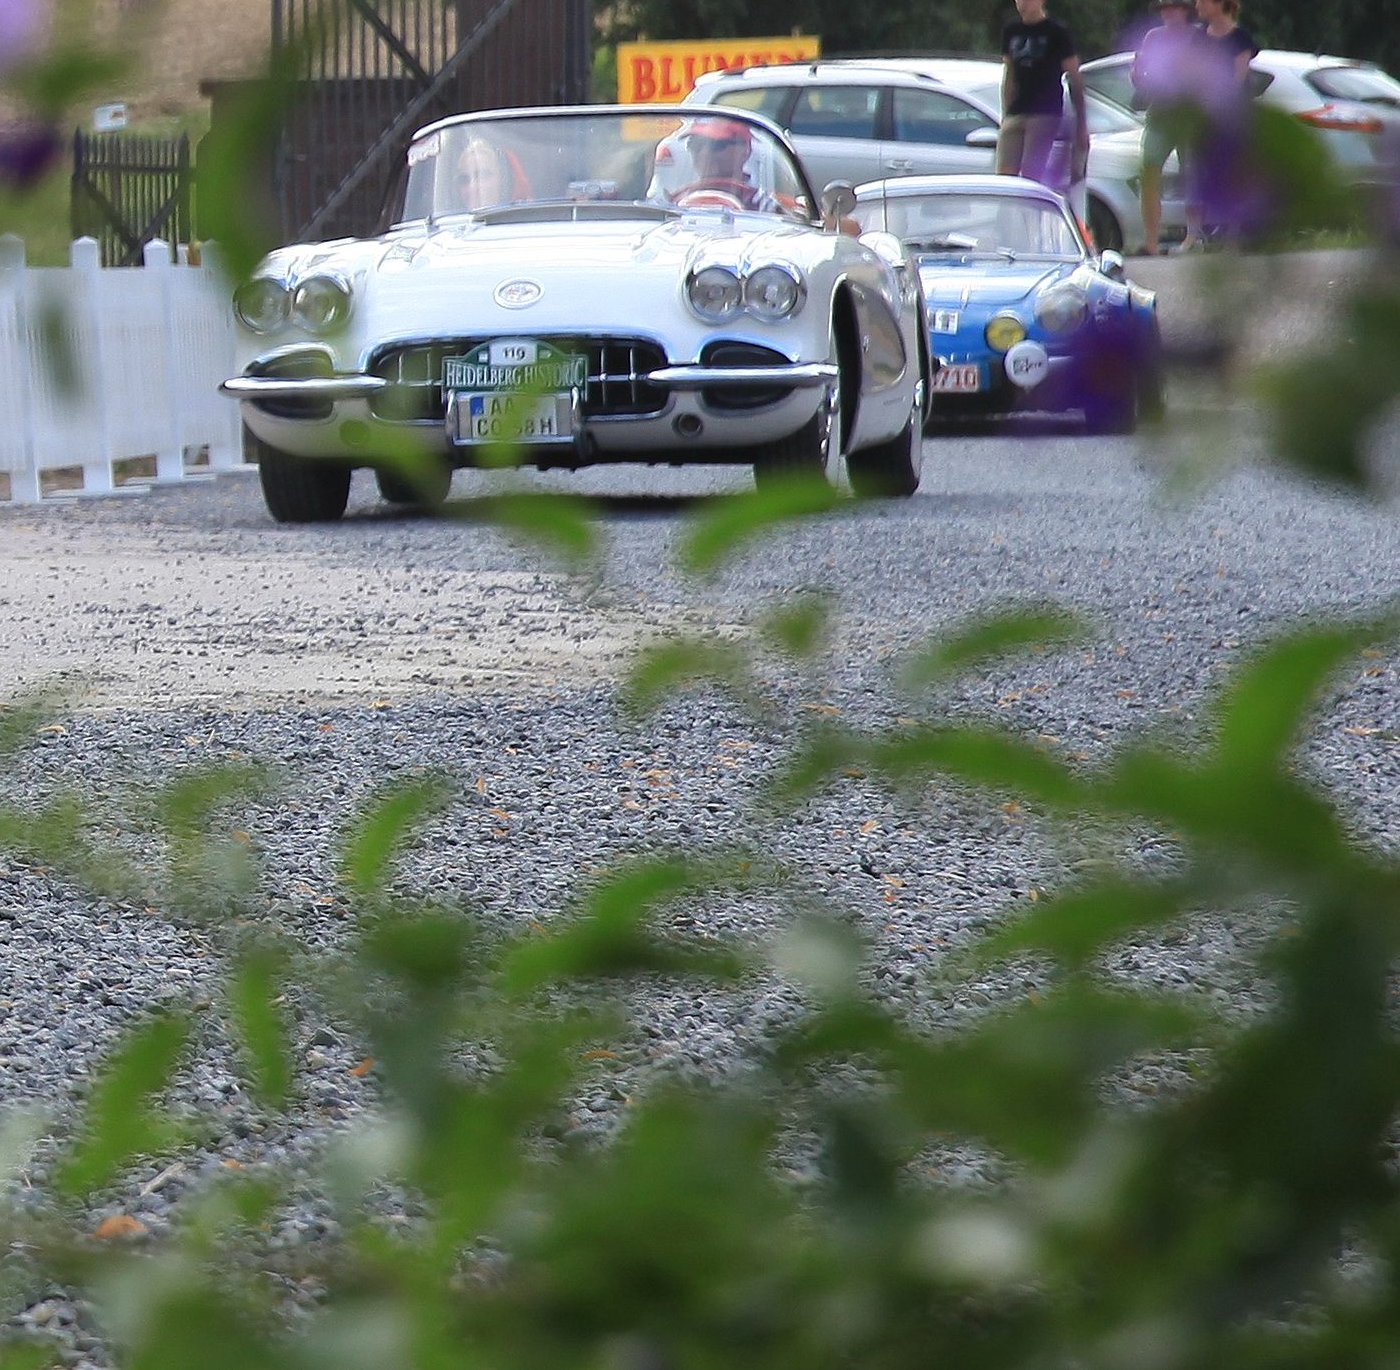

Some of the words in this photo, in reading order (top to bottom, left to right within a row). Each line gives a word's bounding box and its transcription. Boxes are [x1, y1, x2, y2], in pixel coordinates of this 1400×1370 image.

[632, 49, 806, 100] BLUM
[502, 346, 526, 361] 119
[446, 362, 522, 387] HEIDELBERG
[524, 357, 584, 388] HISTORIC
